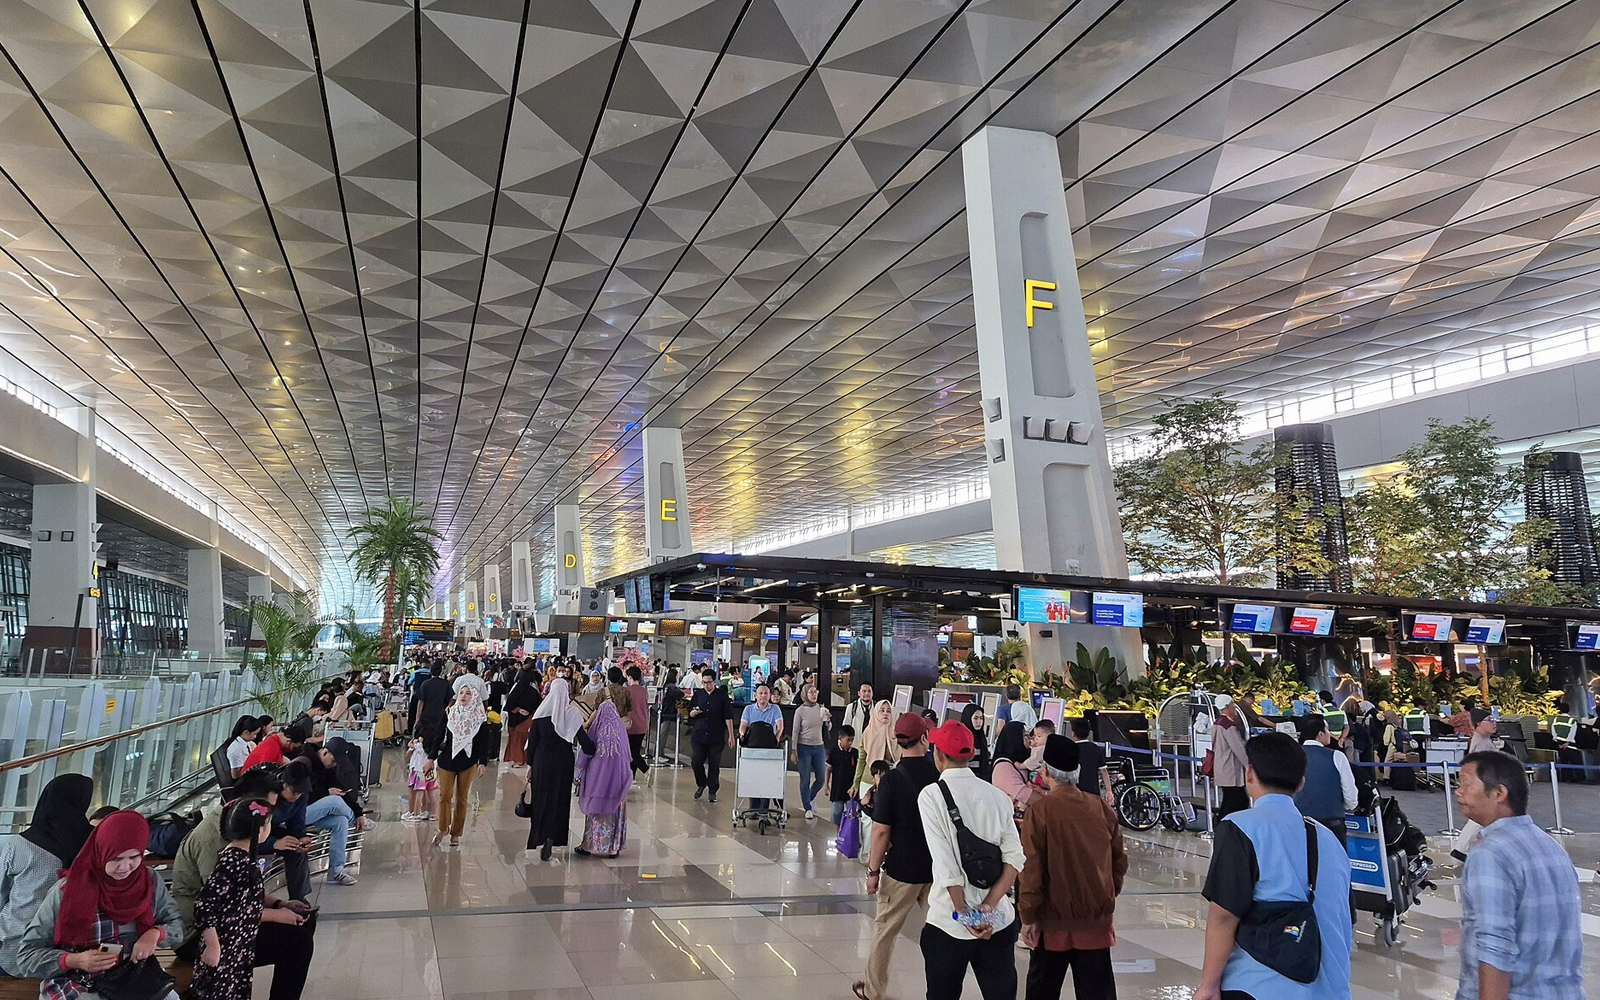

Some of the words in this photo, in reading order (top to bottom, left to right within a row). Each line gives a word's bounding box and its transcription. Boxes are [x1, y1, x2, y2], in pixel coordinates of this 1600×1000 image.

[1025, 279, 1056, 328] F
[661, 499, 677, 521] E
[565, 553, 577, 568] D
[490, 593, 497, 602] C
[468, 602, 475, 610] B
